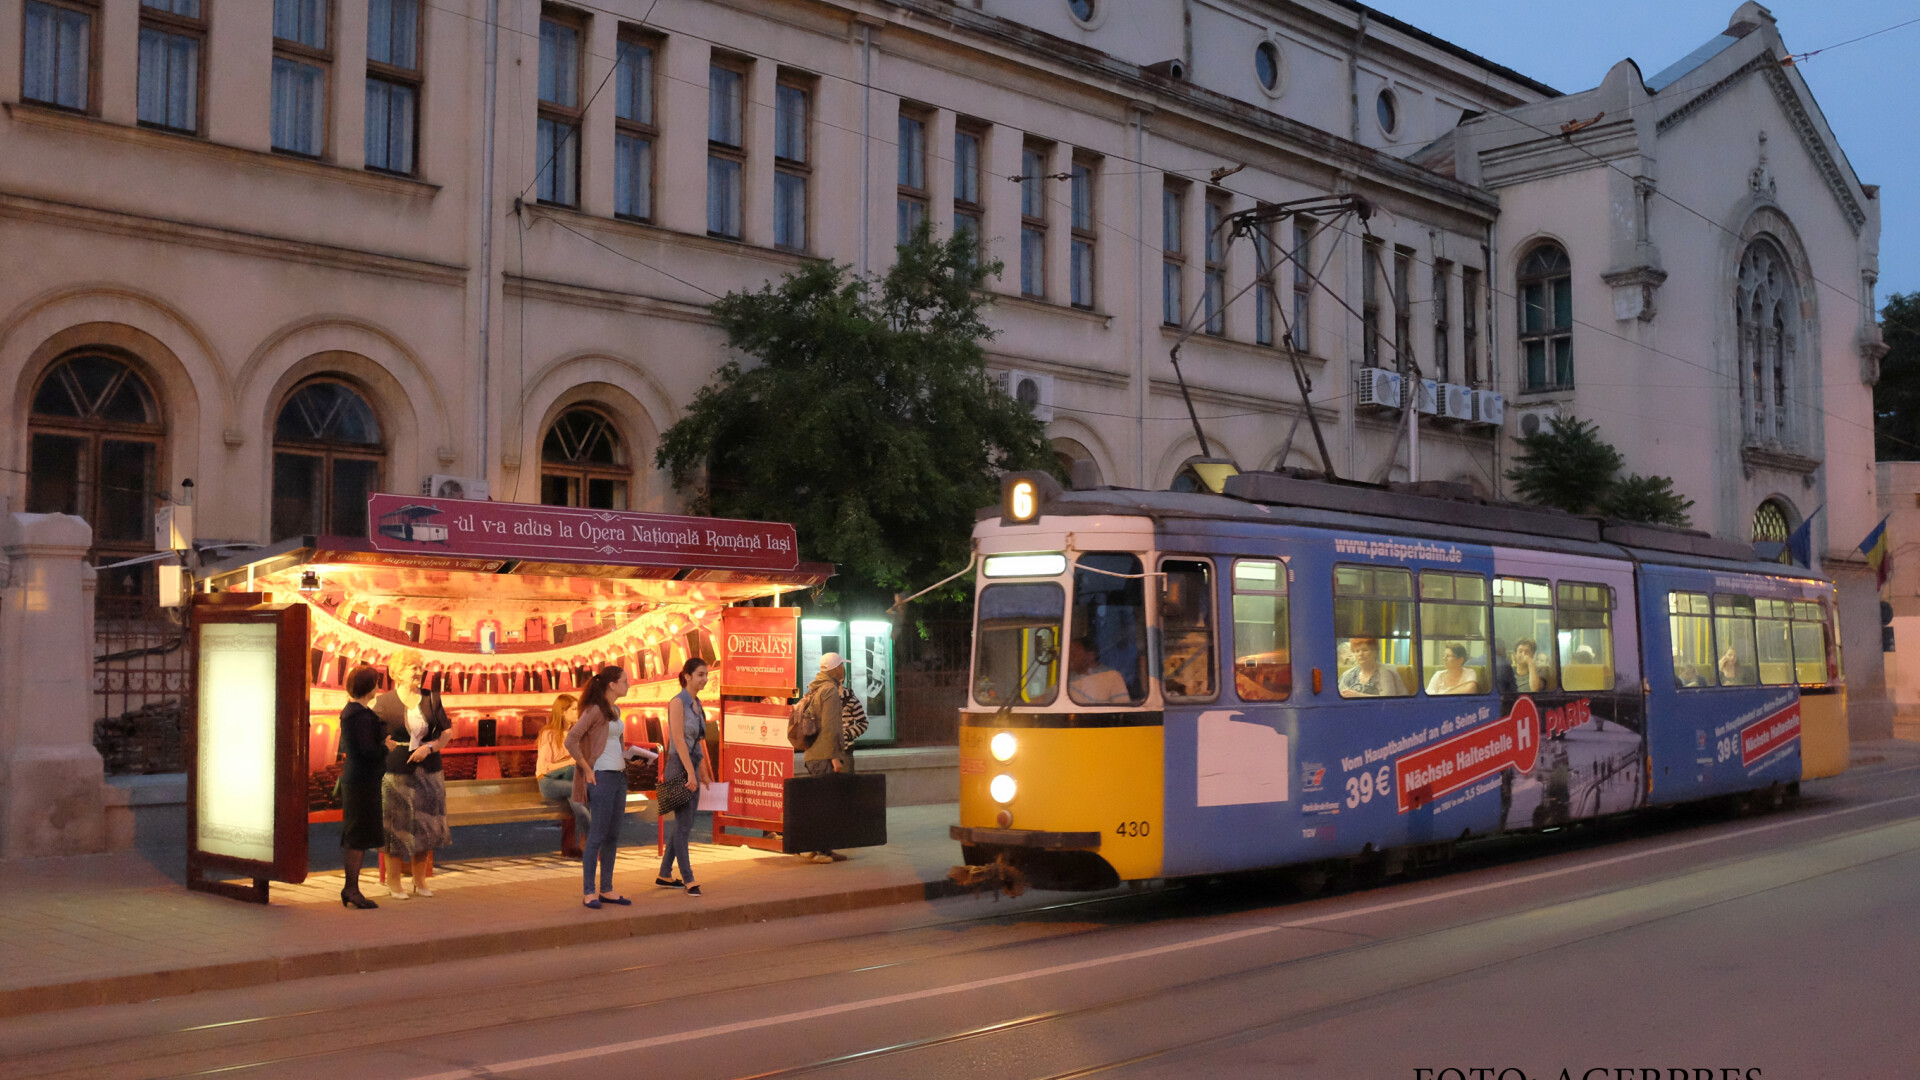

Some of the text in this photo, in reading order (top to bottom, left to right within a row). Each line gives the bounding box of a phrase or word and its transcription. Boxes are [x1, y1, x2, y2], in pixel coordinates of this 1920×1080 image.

[1012, 482, 1031, 518] 6
[482, 519, 507, 534] v-a
[513, 518, 553, 536] adus
[559, 520, 573, 538] la
[579, 521, 625, 543] Opera
[706, 530, 761, 552] Română
[1335, 537, 1463, 564] www.parisperbahn.de
[1545, 697, 1591, 740] PARIS
[1341, 756, 1363, 773] Vom
[1364, 728, 1427, 767] Hauptbahnhof
[1429, 727, 1440, 741] an
[1440, 721, 1454, 736] die
[1455, 711, 1478, 731] Seine
[1478, 706, 1490, 721] für
[1404, 716, 1531, 793] Nächste Haltestelle H
[1745, 730, 1770, 753] Nächste
[733, 757, 784, 780] SUSȚIN
[1116, 821, 1150, 838] 430
